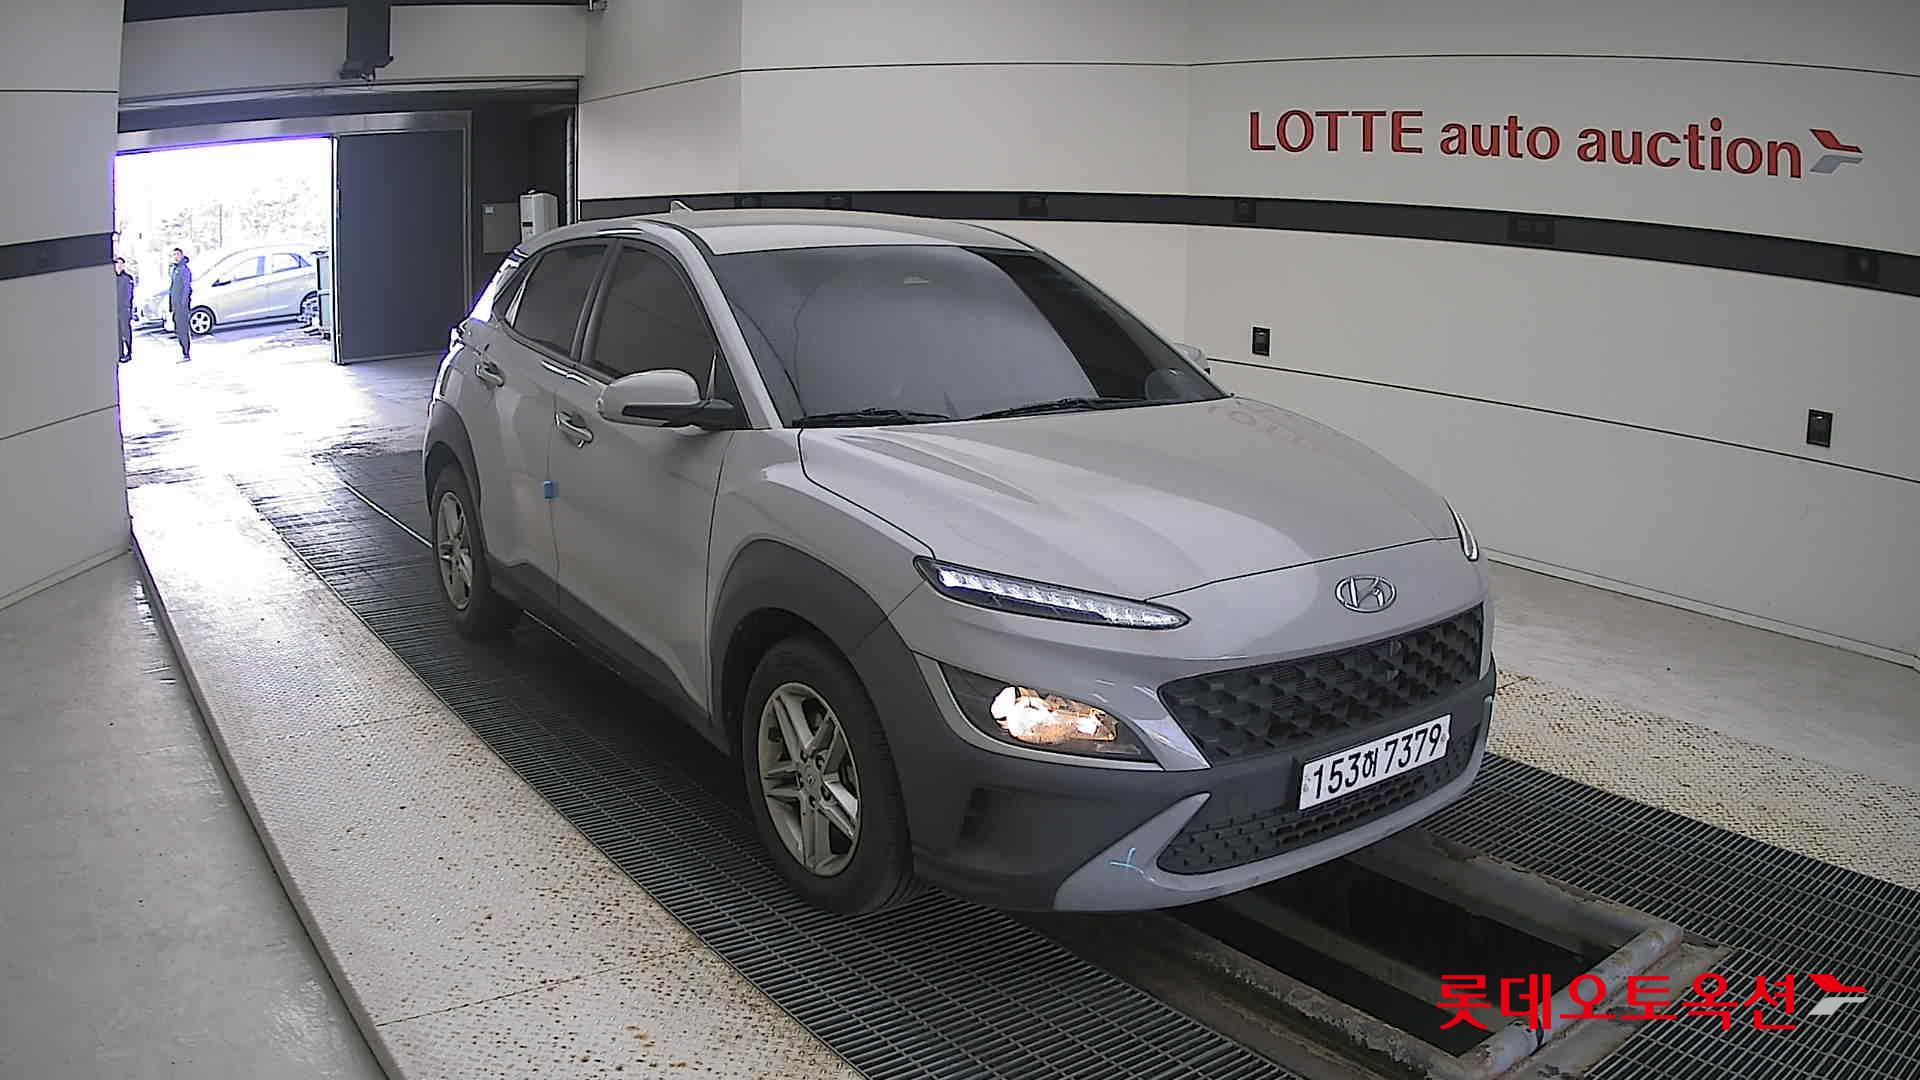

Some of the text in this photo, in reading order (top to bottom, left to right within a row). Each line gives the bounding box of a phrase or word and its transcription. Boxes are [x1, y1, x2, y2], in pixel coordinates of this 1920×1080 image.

[1248, 110, 1803, 179] LOTTE auto auction
